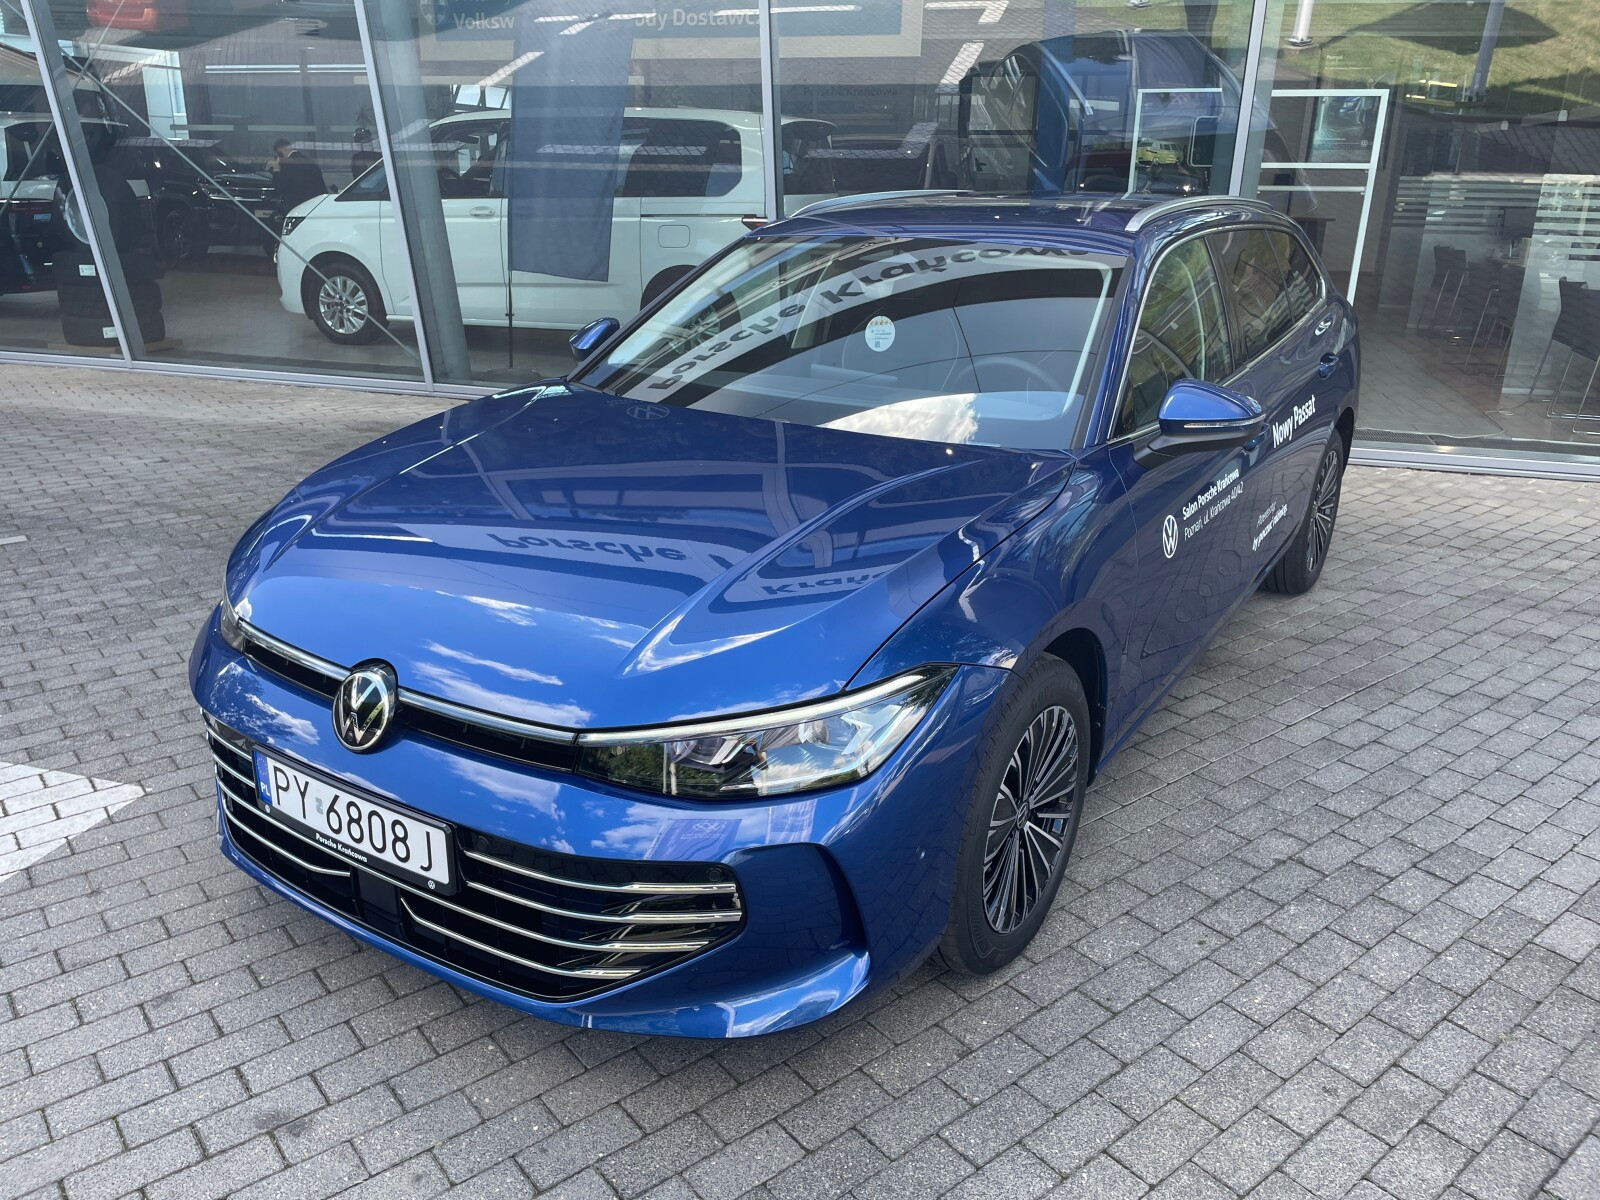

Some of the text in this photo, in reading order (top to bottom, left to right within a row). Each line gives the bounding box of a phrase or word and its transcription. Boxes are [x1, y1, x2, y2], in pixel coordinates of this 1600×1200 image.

[1272, 394, 1316, 448] Nowy Passat
[1182, 502, 1198, 520] Salon
[1197, 485, 1217, 508] Porsche
[260, 783, 270, 797] PL
[273, 765, 309, 819] PY
[315, 832, 337, 849] Porsche
